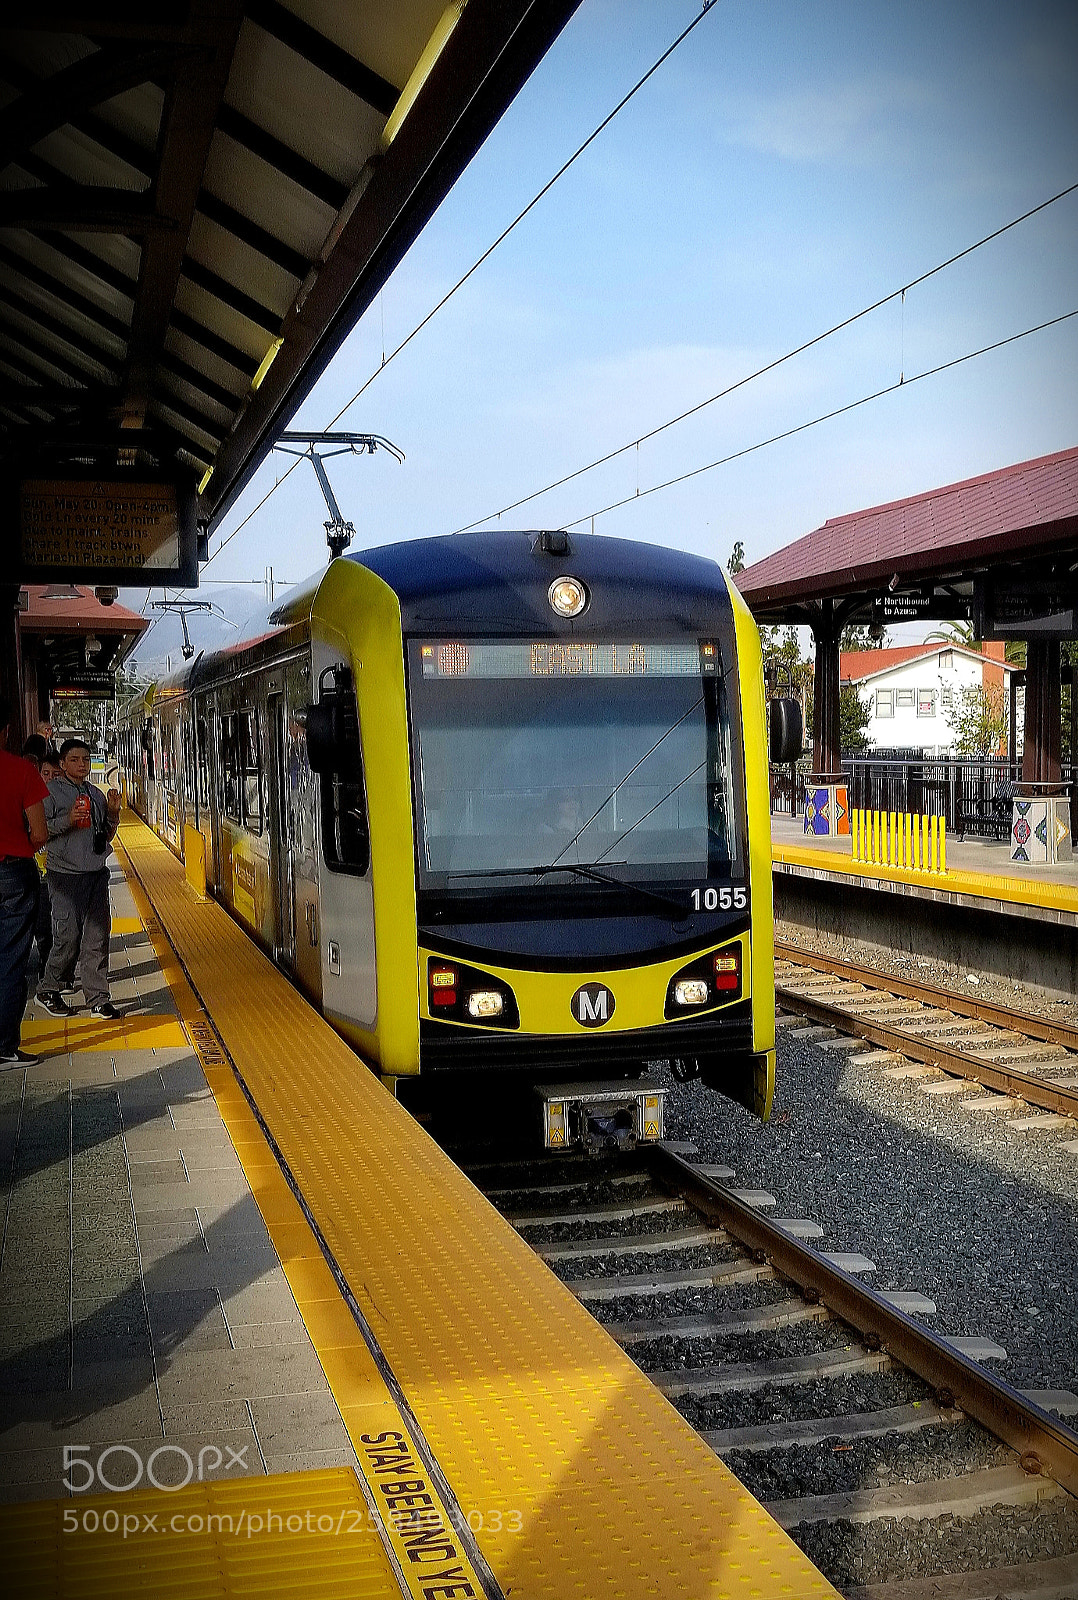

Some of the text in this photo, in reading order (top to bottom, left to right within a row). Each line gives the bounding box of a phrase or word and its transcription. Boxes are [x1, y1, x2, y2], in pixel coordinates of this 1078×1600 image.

[54, 498, 80, 511] May
[75, 515, 110, 526] every
[113, 514, 128, 524] 20
[51, 526, 63, 536] to
[109, 527, 149, 538] Trains
[74, 539, 107, 551] track
[110, 540, 141, 551] btwn
[884, 597, 930, 606] Northbound
[884, 606, 918, 615] to Azusa
[965, 605, 971, 617] 1
[530, 643, 646, 675] EAST LA
[691, 887, 747, 911] 1055
[579, 990, 608, 1021] M
[360, 1432, 418, 1474] STAY
[379, 1480, 457, 1563] BEHIND
